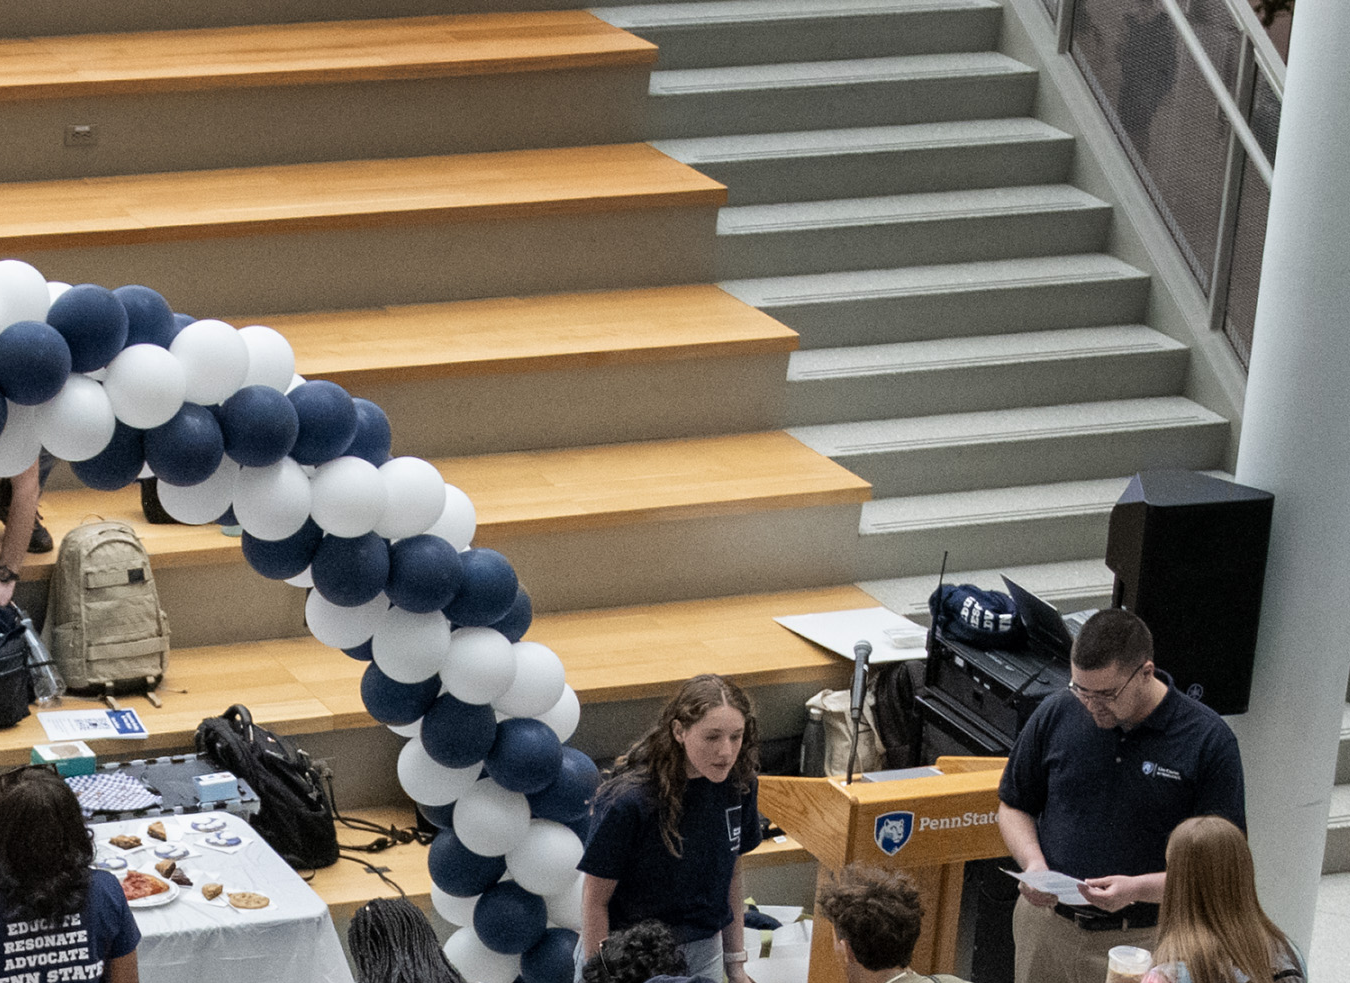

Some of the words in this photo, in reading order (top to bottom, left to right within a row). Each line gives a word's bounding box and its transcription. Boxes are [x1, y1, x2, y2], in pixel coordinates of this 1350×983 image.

[3, 929, 88, 955] RESONATE
[3, 947, 90, 972] ADVOCATE
[46, 959, 105, 983] STATE
